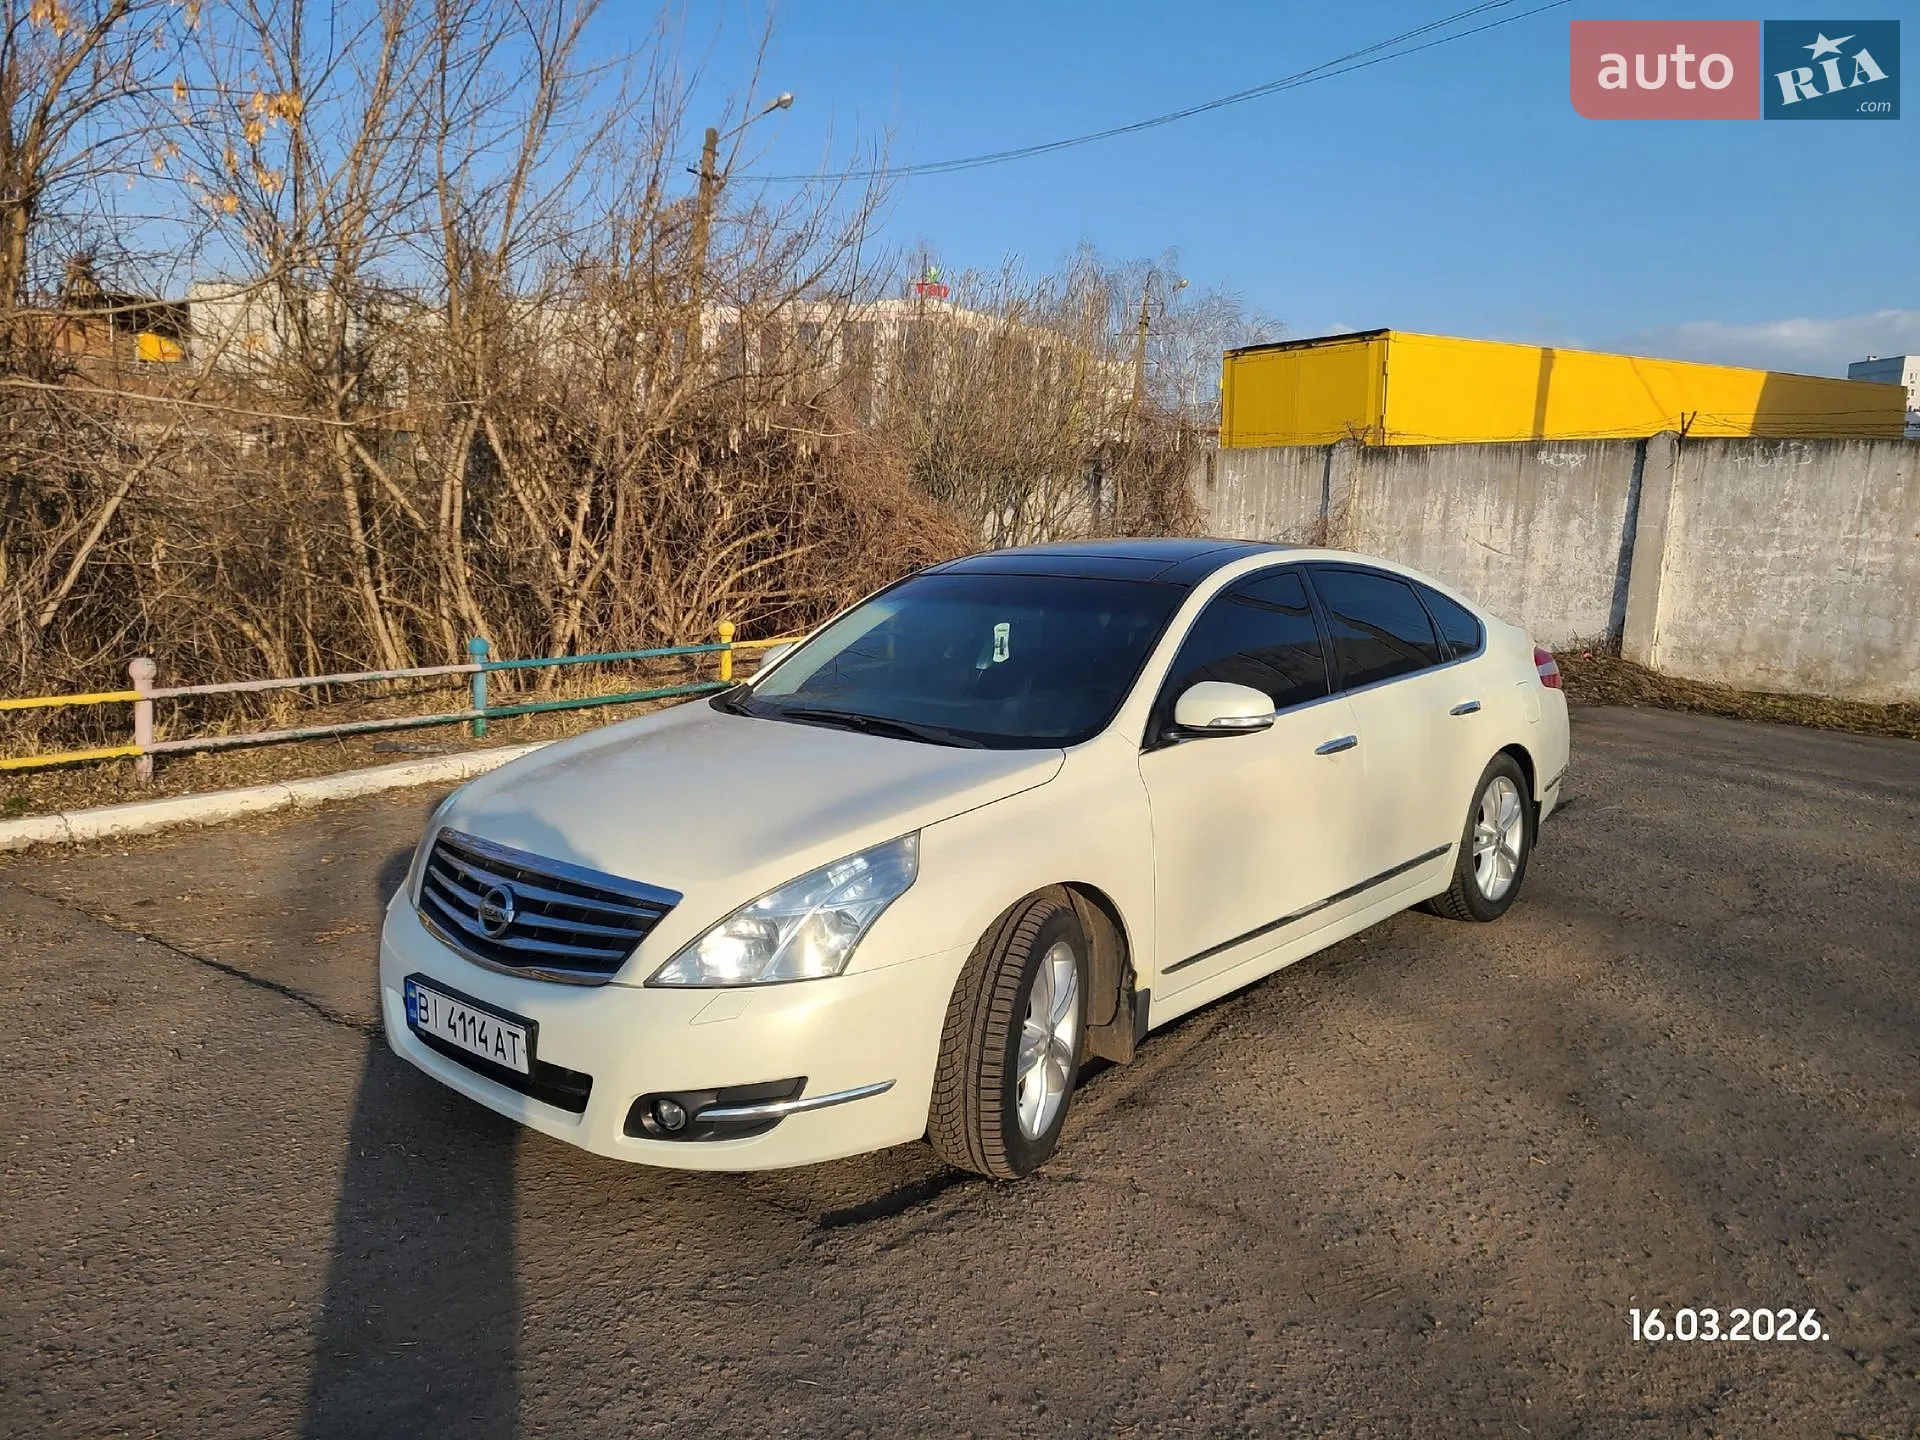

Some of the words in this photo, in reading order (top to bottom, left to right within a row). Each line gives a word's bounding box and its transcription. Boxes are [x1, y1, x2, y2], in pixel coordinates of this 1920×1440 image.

[418, 992, 438, 1029] BI
[447, 1006, 488, 1053] 4114
[495, 1026, 520, 1065] AT
